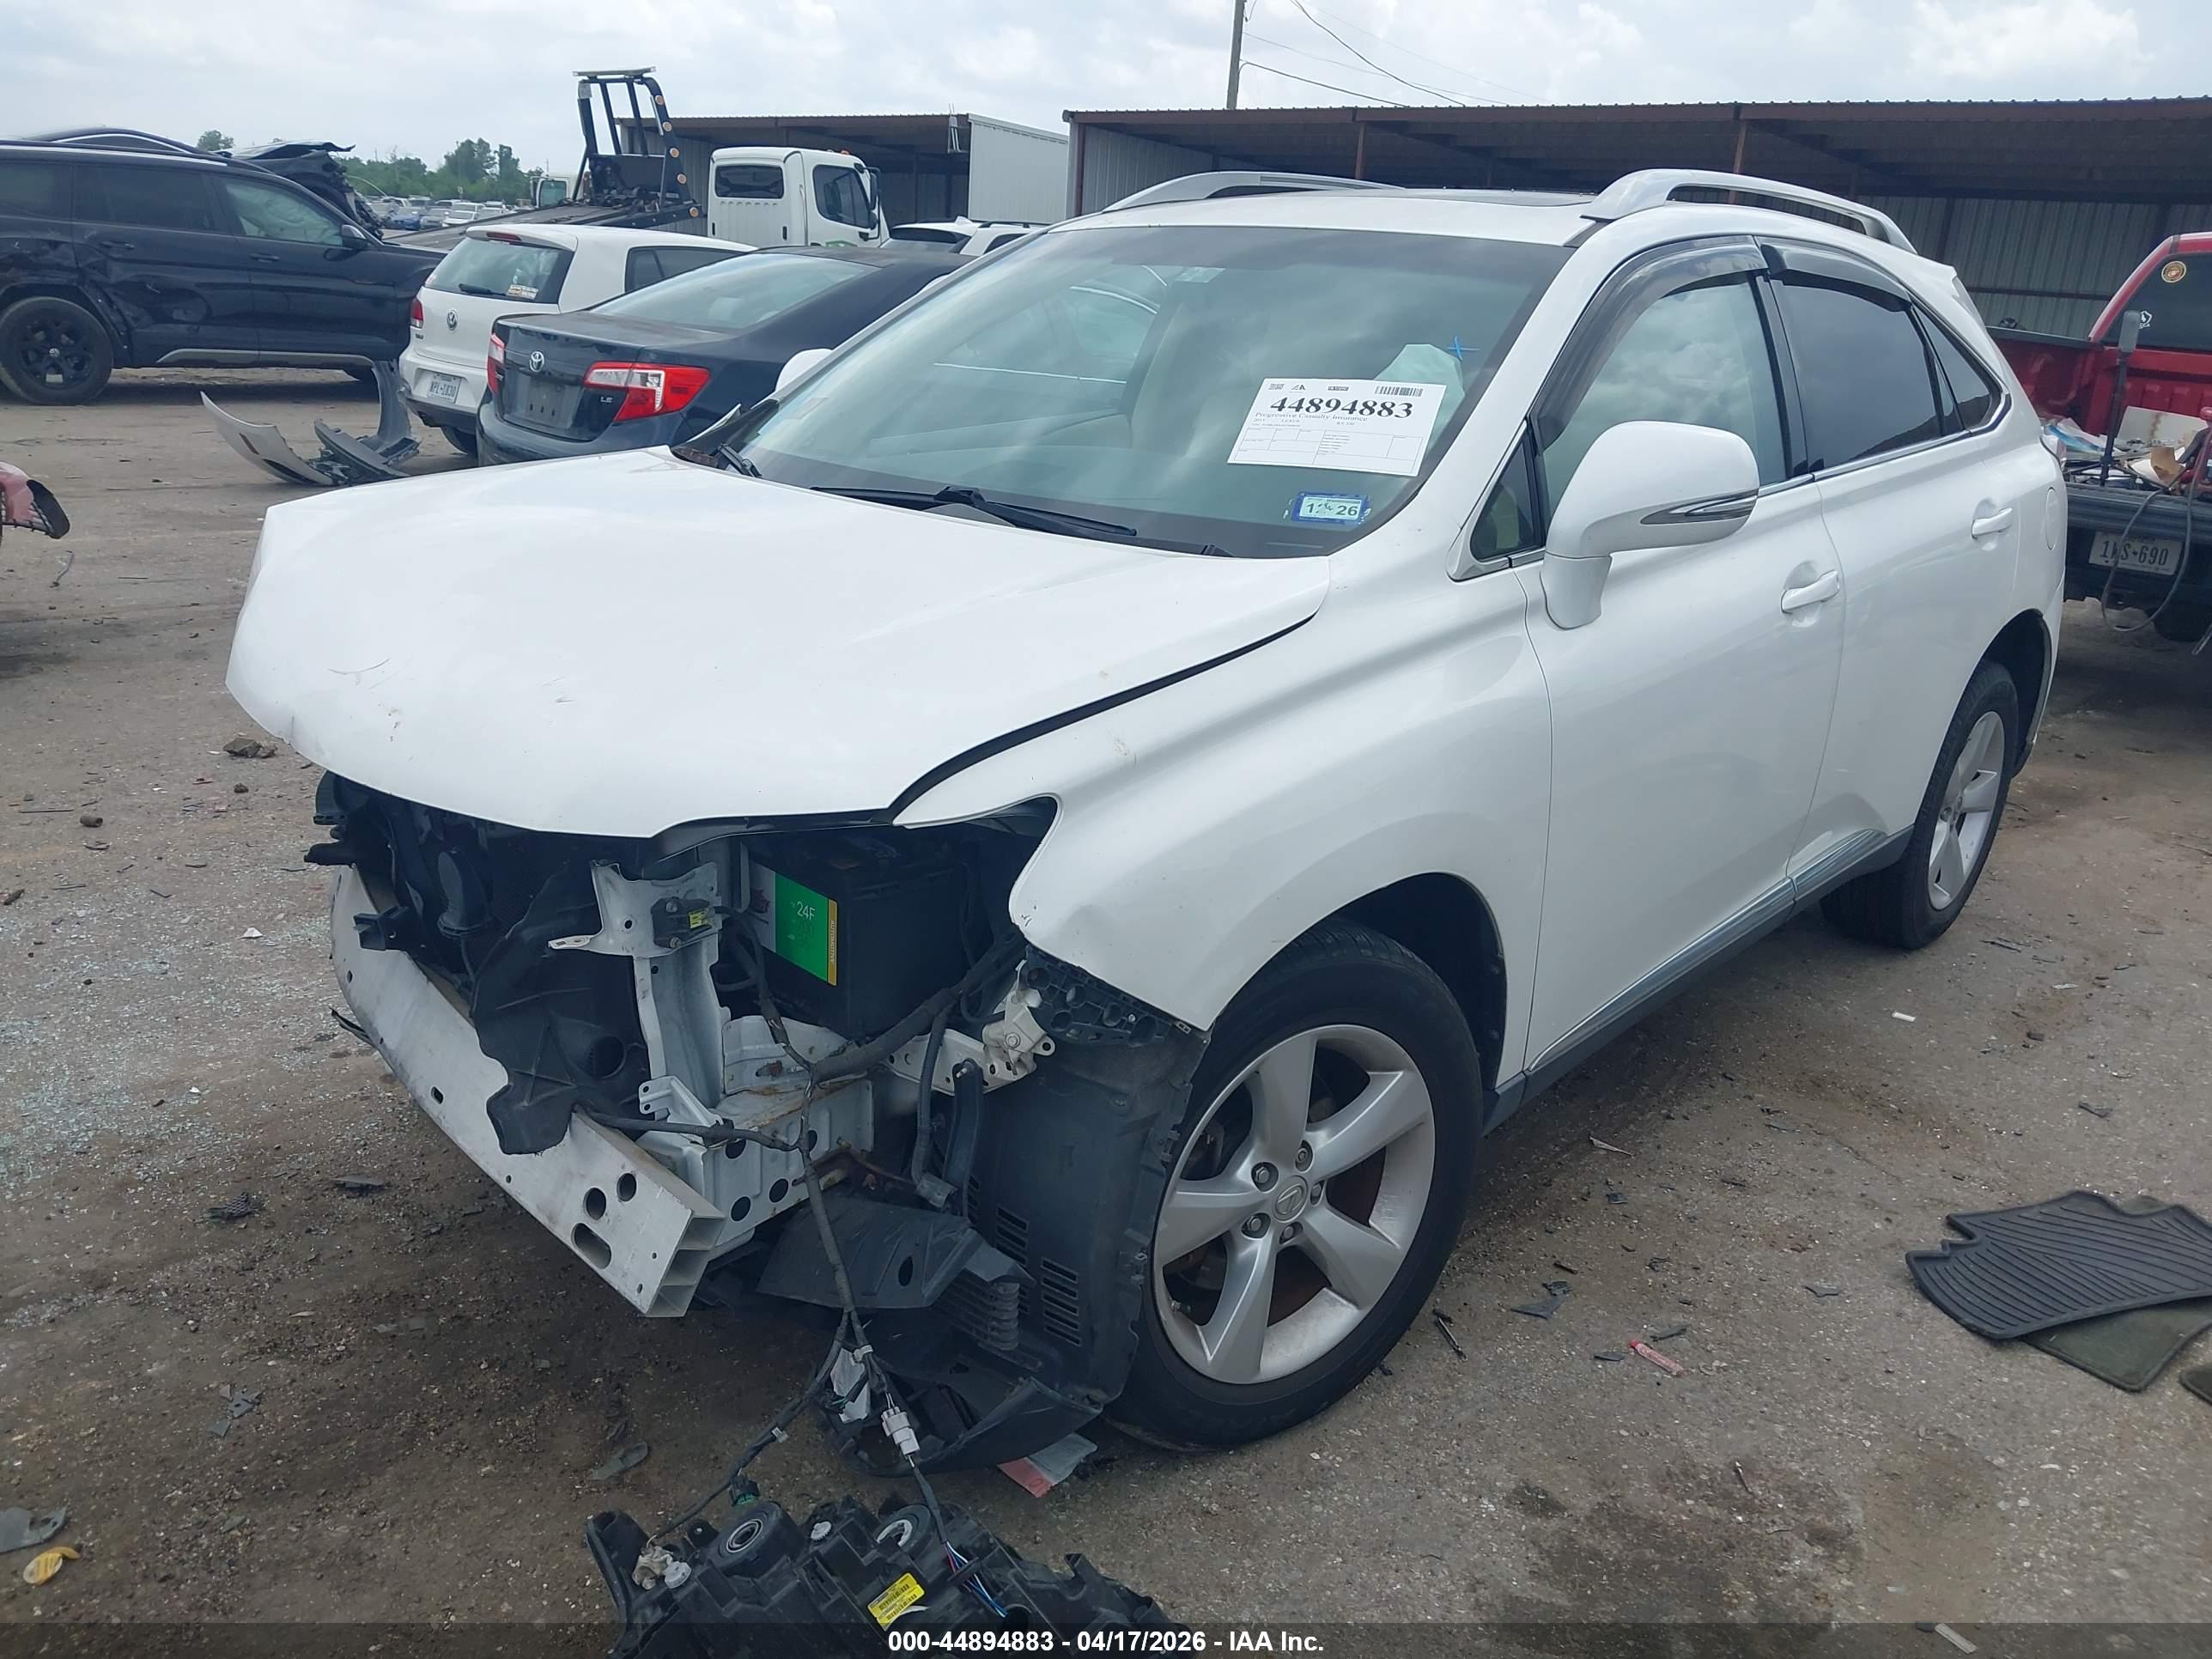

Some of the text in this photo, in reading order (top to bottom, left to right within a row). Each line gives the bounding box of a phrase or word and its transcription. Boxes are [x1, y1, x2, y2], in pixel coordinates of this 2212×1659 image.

[1270, 397, 1413, 418] 44894883
[1335, 505, 1358, 516] 26
[797, 901, 816, 921] 24F
